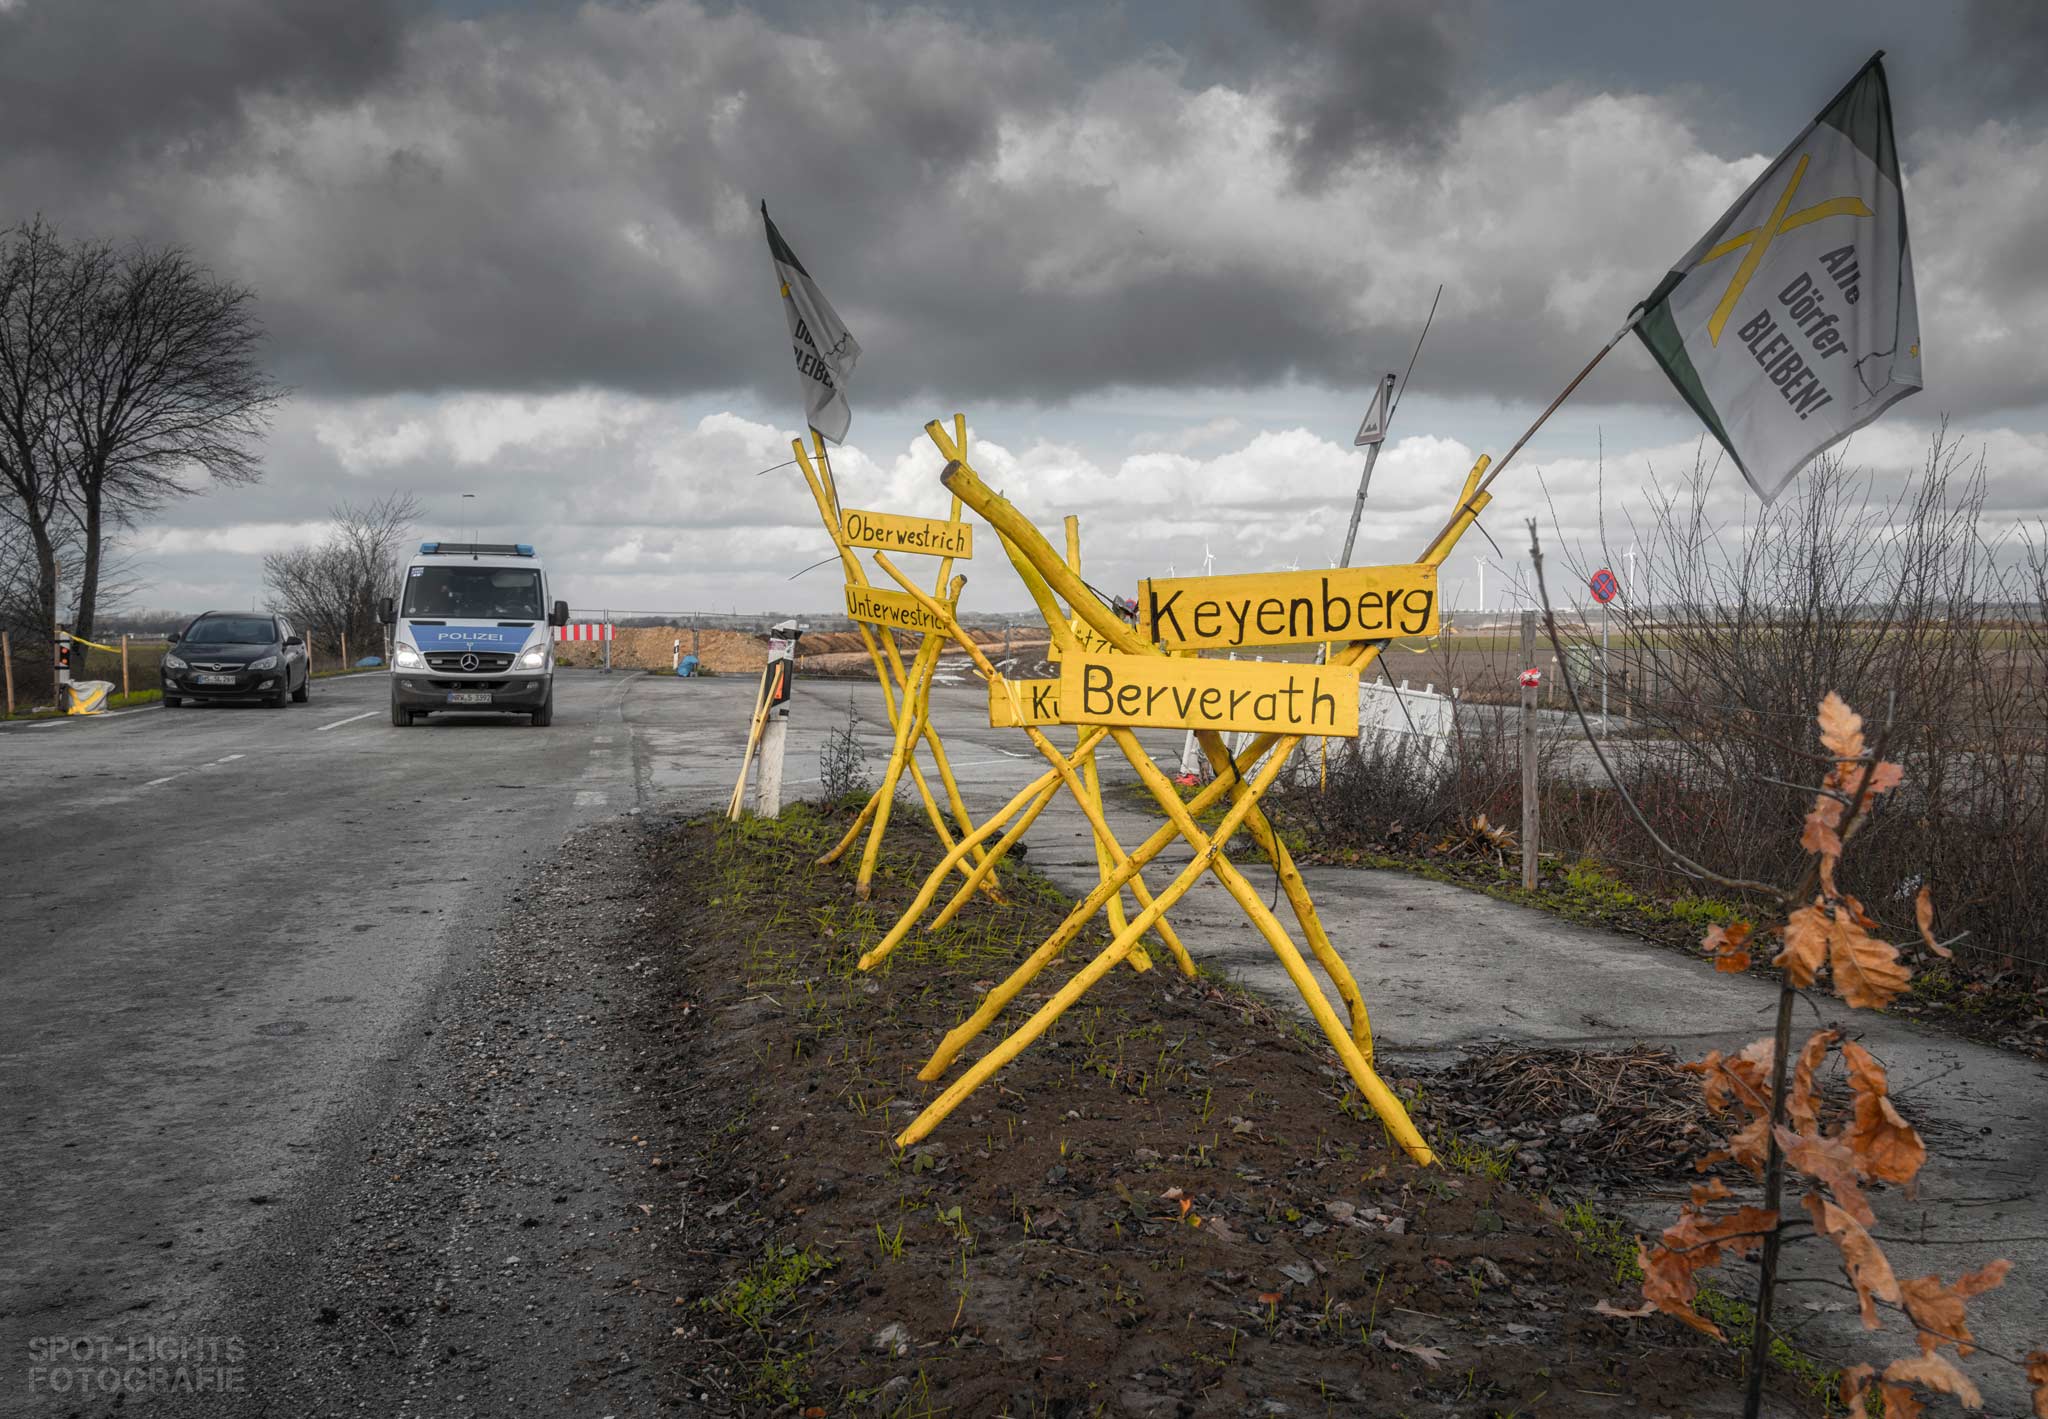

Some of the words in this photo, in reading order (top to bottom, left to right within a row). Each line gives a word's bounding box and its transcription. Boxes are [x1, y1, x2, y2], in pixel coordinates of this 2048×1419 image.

[1819, 245, 1861, 305] Alle
[1778, 272, 1848, 359] Dörfer
[1737, 308, 1833, 420] BLEIBEN!
[847, 514, 965, 552] Oberwestrich
[438, 632, 503, 641] POLIZEI
[846, 590, 949, 631] Unterwestric
[1150, 577, 1434, 645] Keyenberg
[1083, 664, 1336, 726] Berverath
